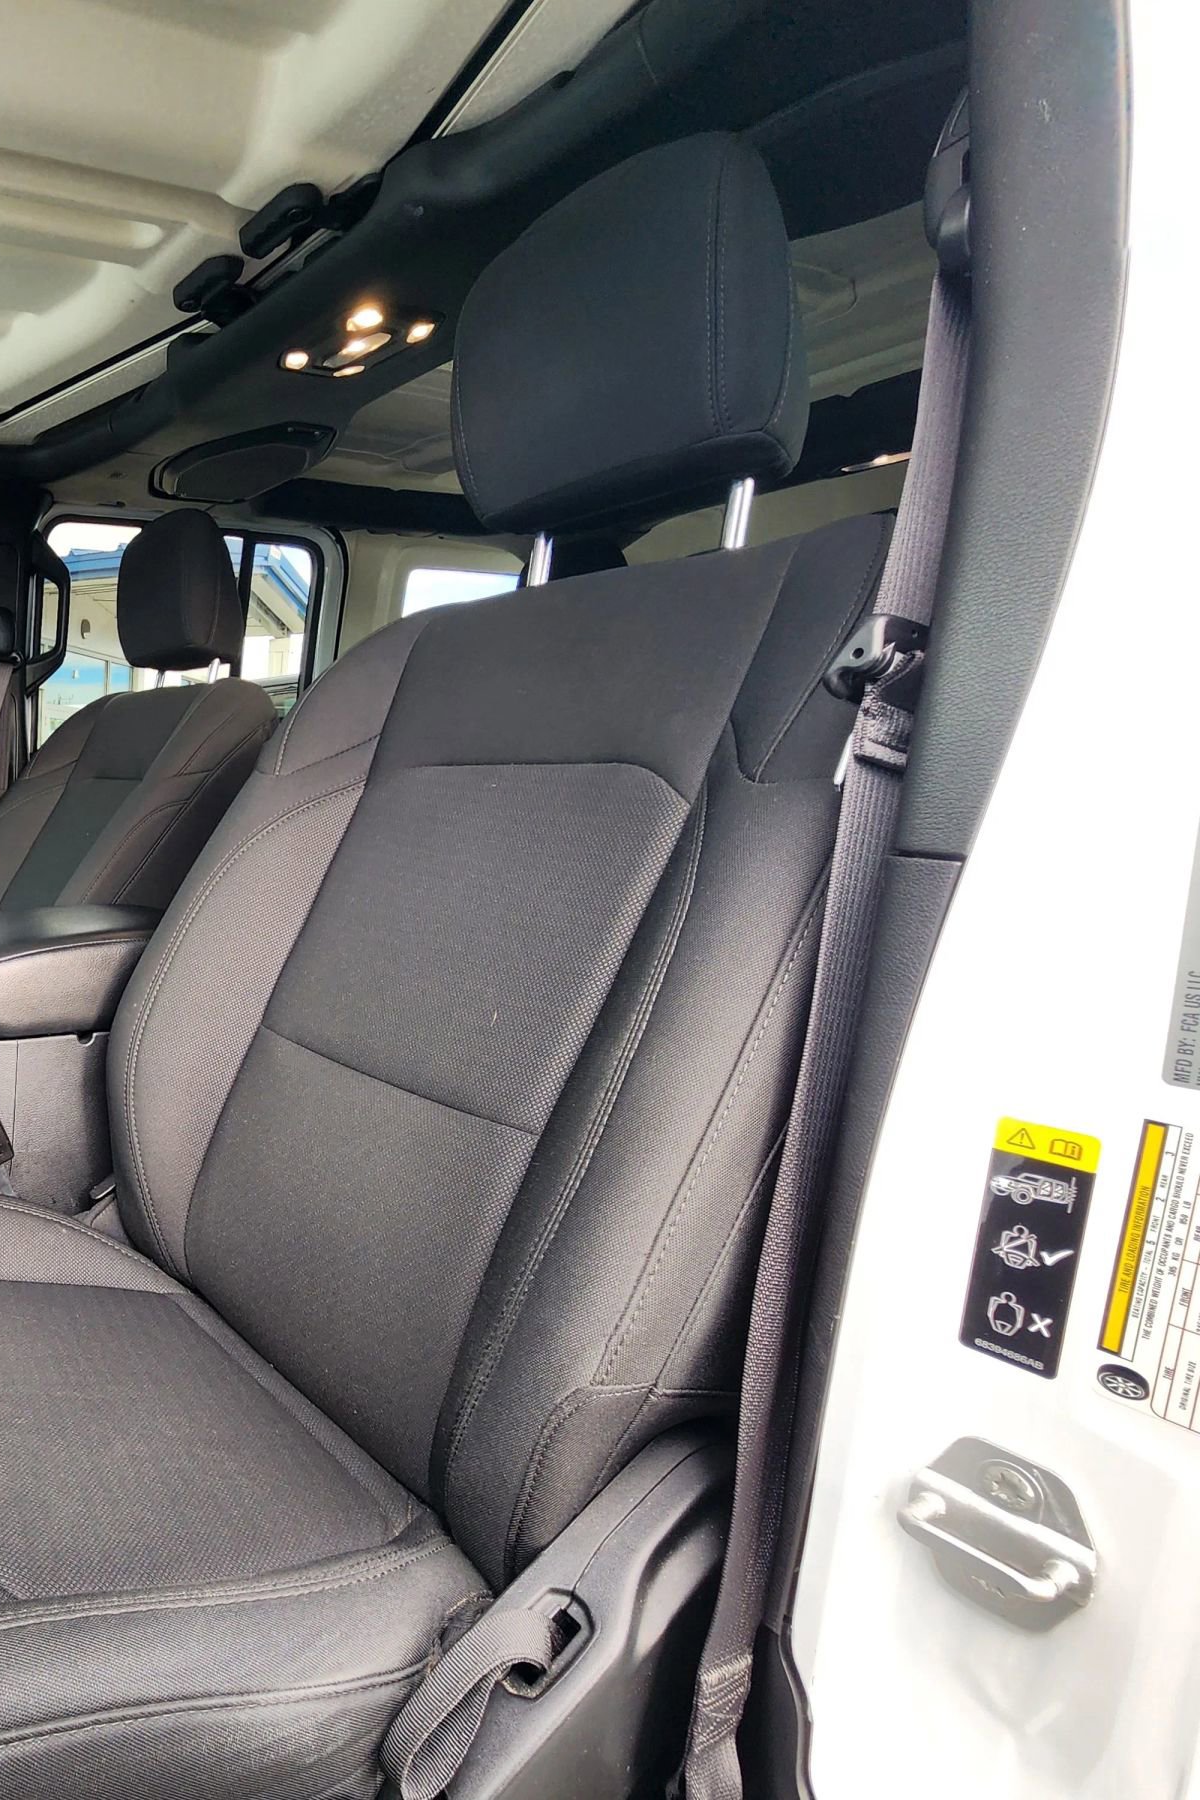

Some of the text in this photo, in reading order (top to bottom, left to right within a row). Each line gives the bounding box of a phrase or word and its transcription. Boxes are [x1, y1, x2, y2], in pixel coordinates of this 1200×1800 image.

[1184, 993, 1200, 1008] US
[1181, 1012, 1199, 1032] FCA
[1177, 1037, 1196, 1055] BY:
[1173, 1058, 1192, 1083] MFD
[1181, 1132, 1193, 1155] EXCEED
[1177, 1156, 1188, 1175] NEVER
[1172, 1176, 1184, 1199] SHOULD
[1168, 1200, 1179, 1220] CARGO
[1165, 1220, 1174, 1233] AND
[1119, 1185, 1149, 1294] TIRE AND LOADING INFORMATION
[1158, 1234, 1171, 1267] OCCUPANTS
[1136, 1272, 1147, 1297] CAPACITY
[1151, 1277, 1162, 1299] WEIGHT
[1145, 1299, 1158, 1329] COMBINED
[1142, 1329, 1151, 1340] THE
